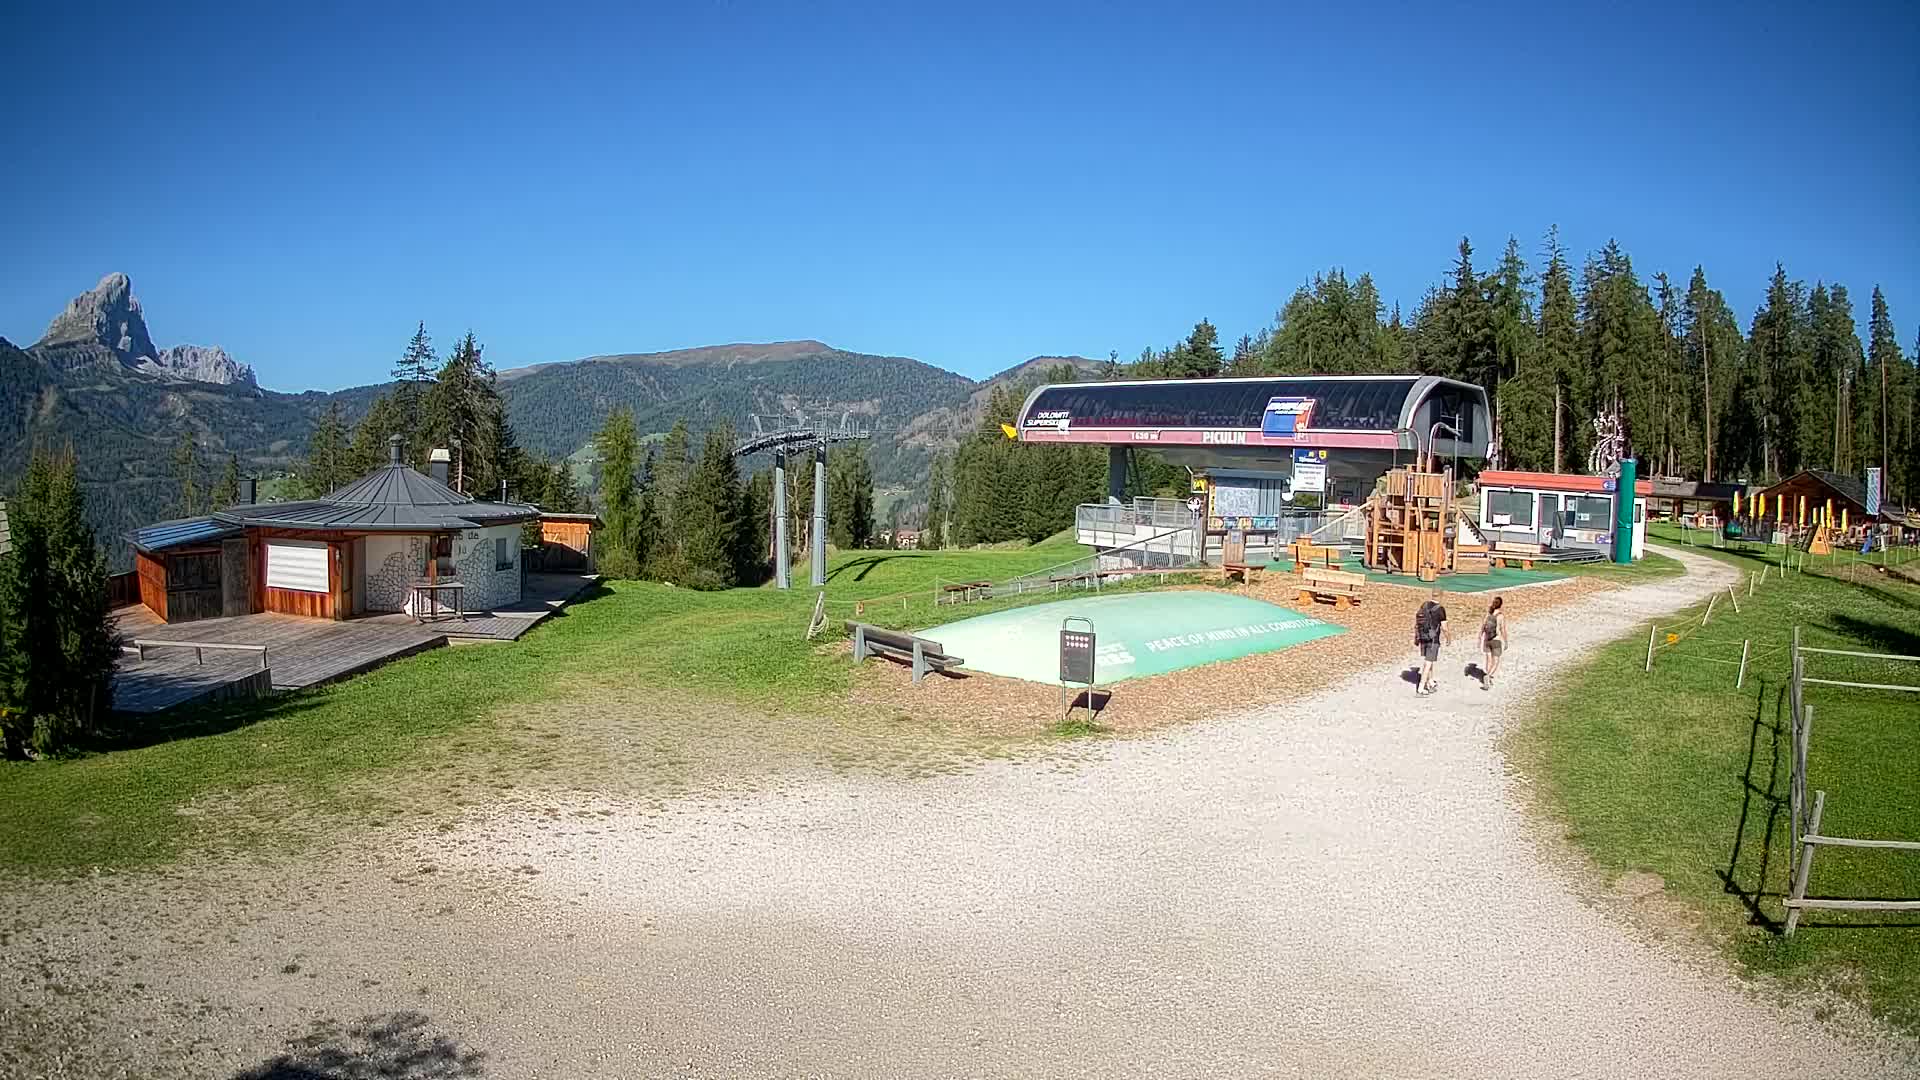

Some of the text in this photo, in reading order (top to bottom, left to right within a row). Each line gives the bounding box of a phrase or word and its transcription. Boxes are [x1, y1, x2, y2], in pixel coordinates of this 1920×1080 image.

[1037, 411, 1070, 419] DOLOMITI
[1202, 432, 1246, 443] PICULIN
[1144, 636, 1190, 653] PEACE
[1189, 633, 1206, 647] OF
[1206, 629, 1236, 642] MIND
[1248, 624, 1271, 635] ALL
